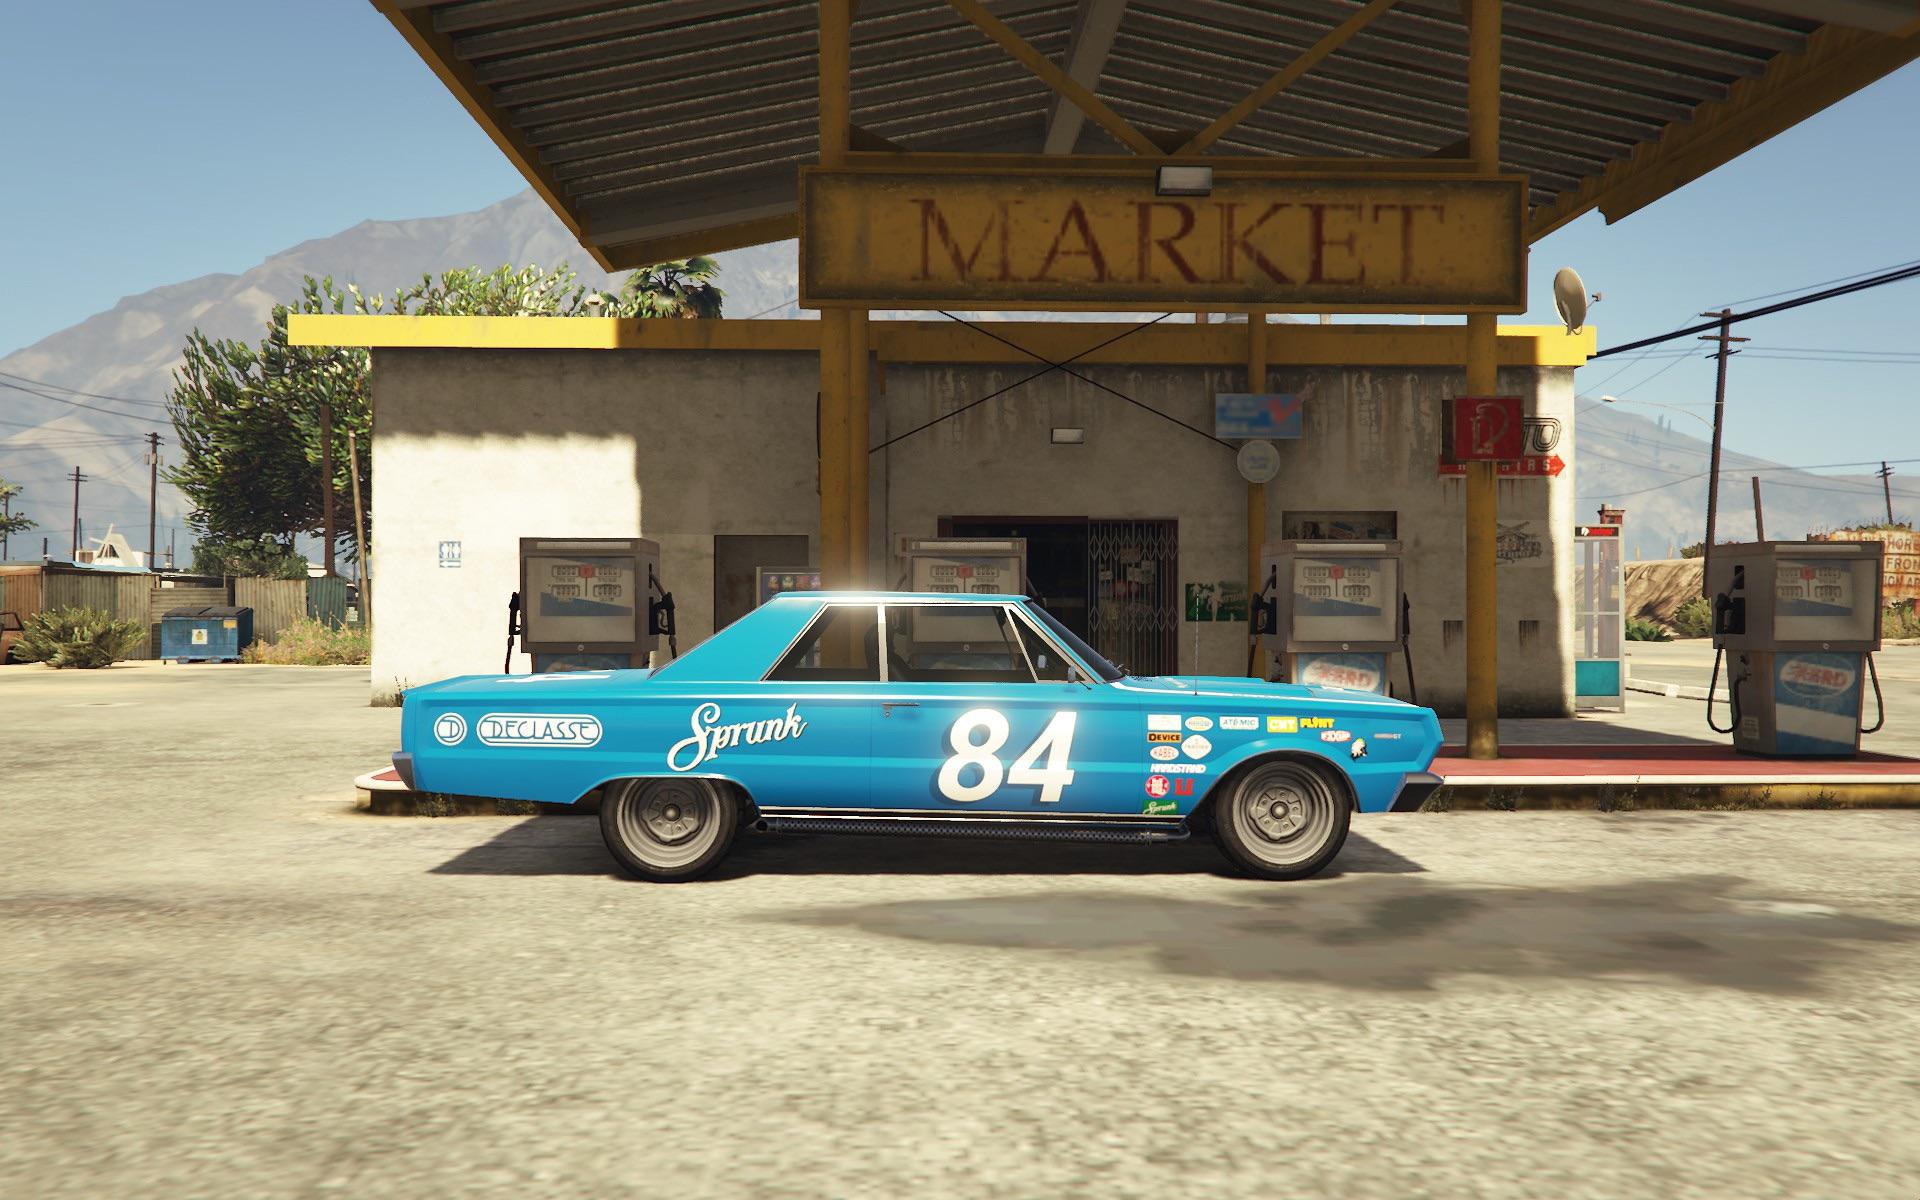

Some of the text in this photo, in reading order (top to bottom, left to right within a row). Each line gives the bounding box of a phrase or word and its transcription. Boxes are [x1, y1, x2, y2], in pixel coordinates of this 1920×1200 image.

[909, 199, 1444, 285] MARKET
[479, 718, 599, 742] DECLASSE
[666, 702, 807, 772] Sprunk
[938, 708, 1077, 802] 84
[1148, 733, 1181, 741] DEVICE
